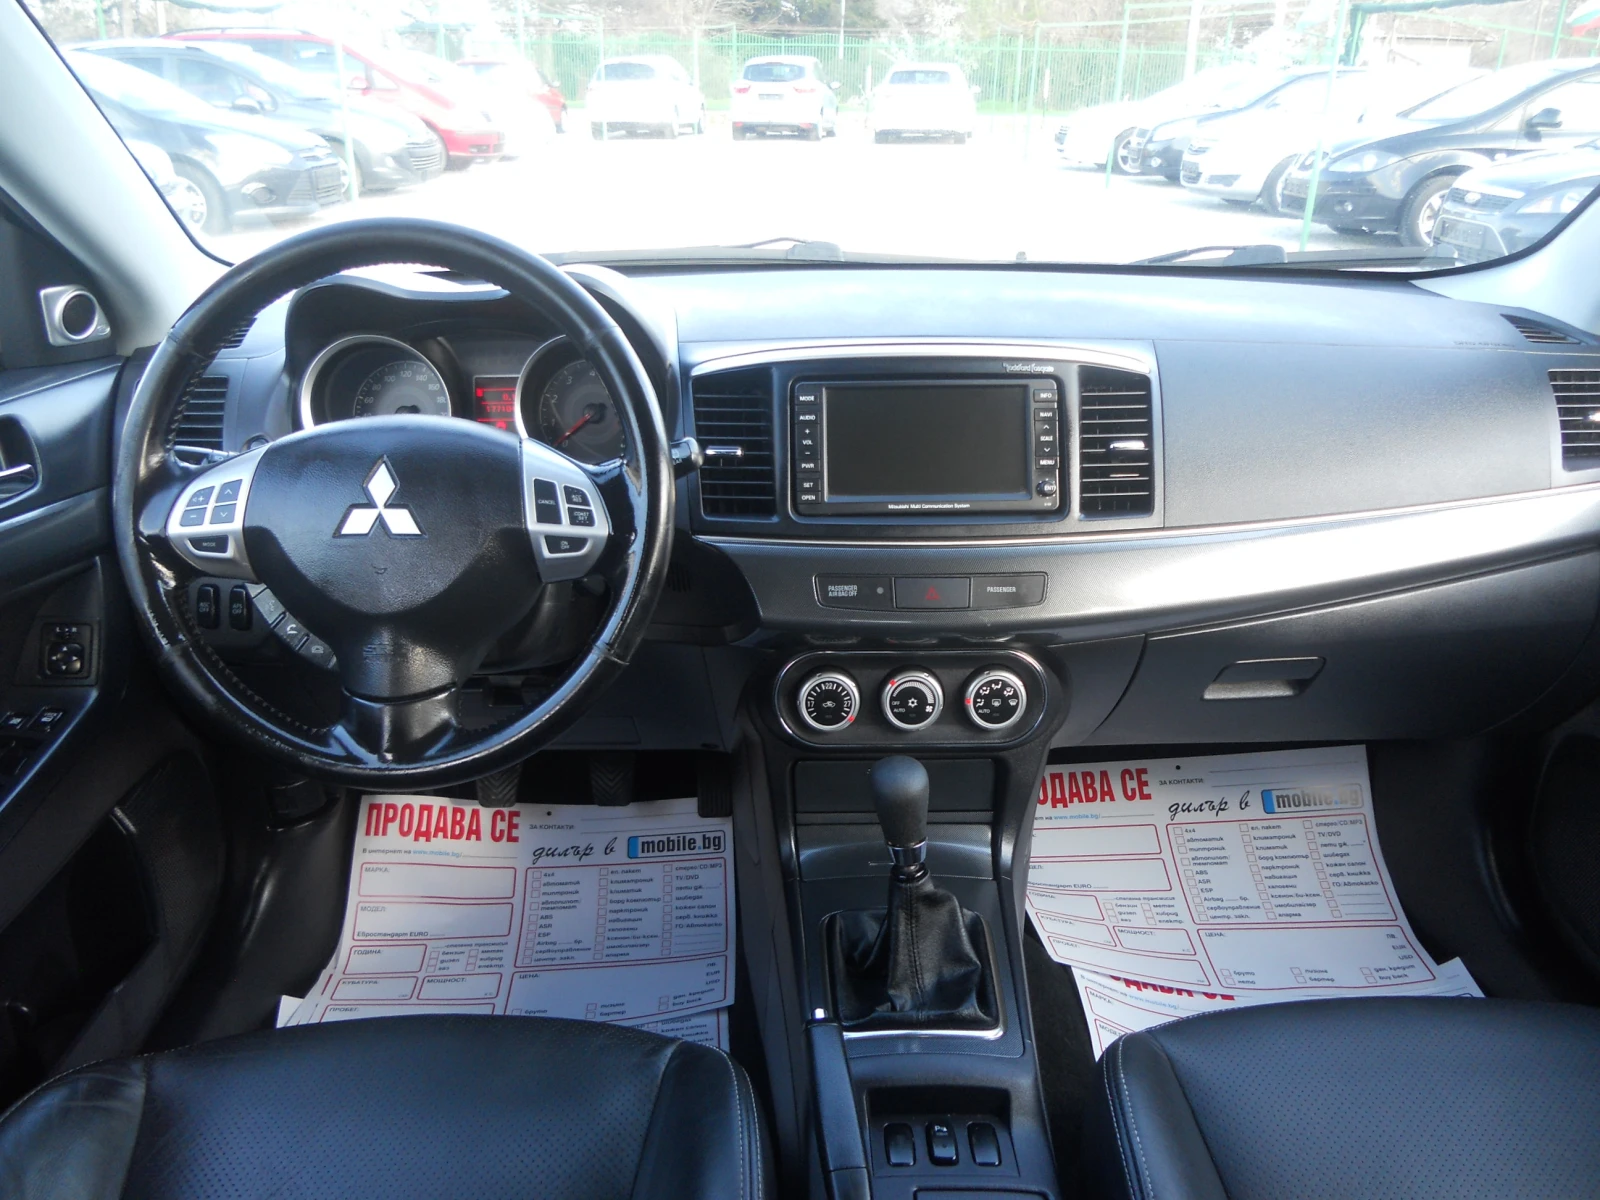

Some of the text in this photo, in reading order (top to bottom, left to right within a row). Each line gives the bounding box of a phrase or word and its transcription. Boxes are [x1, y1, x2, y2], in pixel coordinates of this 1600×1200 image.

[400, 370, 412, 378] 120
[566, 376, 573, 385] 3
[551, 395, 558, 404] 2
[825, 682, 833, 690] 22
[1037, 767, 1152, 809] ОДАВА СЕ
[1275, 788, 1360, 809] mobile.bg
[1168, 797, 1230, 821] дилър
[365, 802, 521, 843] ПРОДАВА СЕ
[641, 834, 722, 854] mobile.bg
[1253, 833, 1297, 841] климатроник
[532, 842, 595, 865] дилър
[1261, 863, 1300, 871] парктроник
